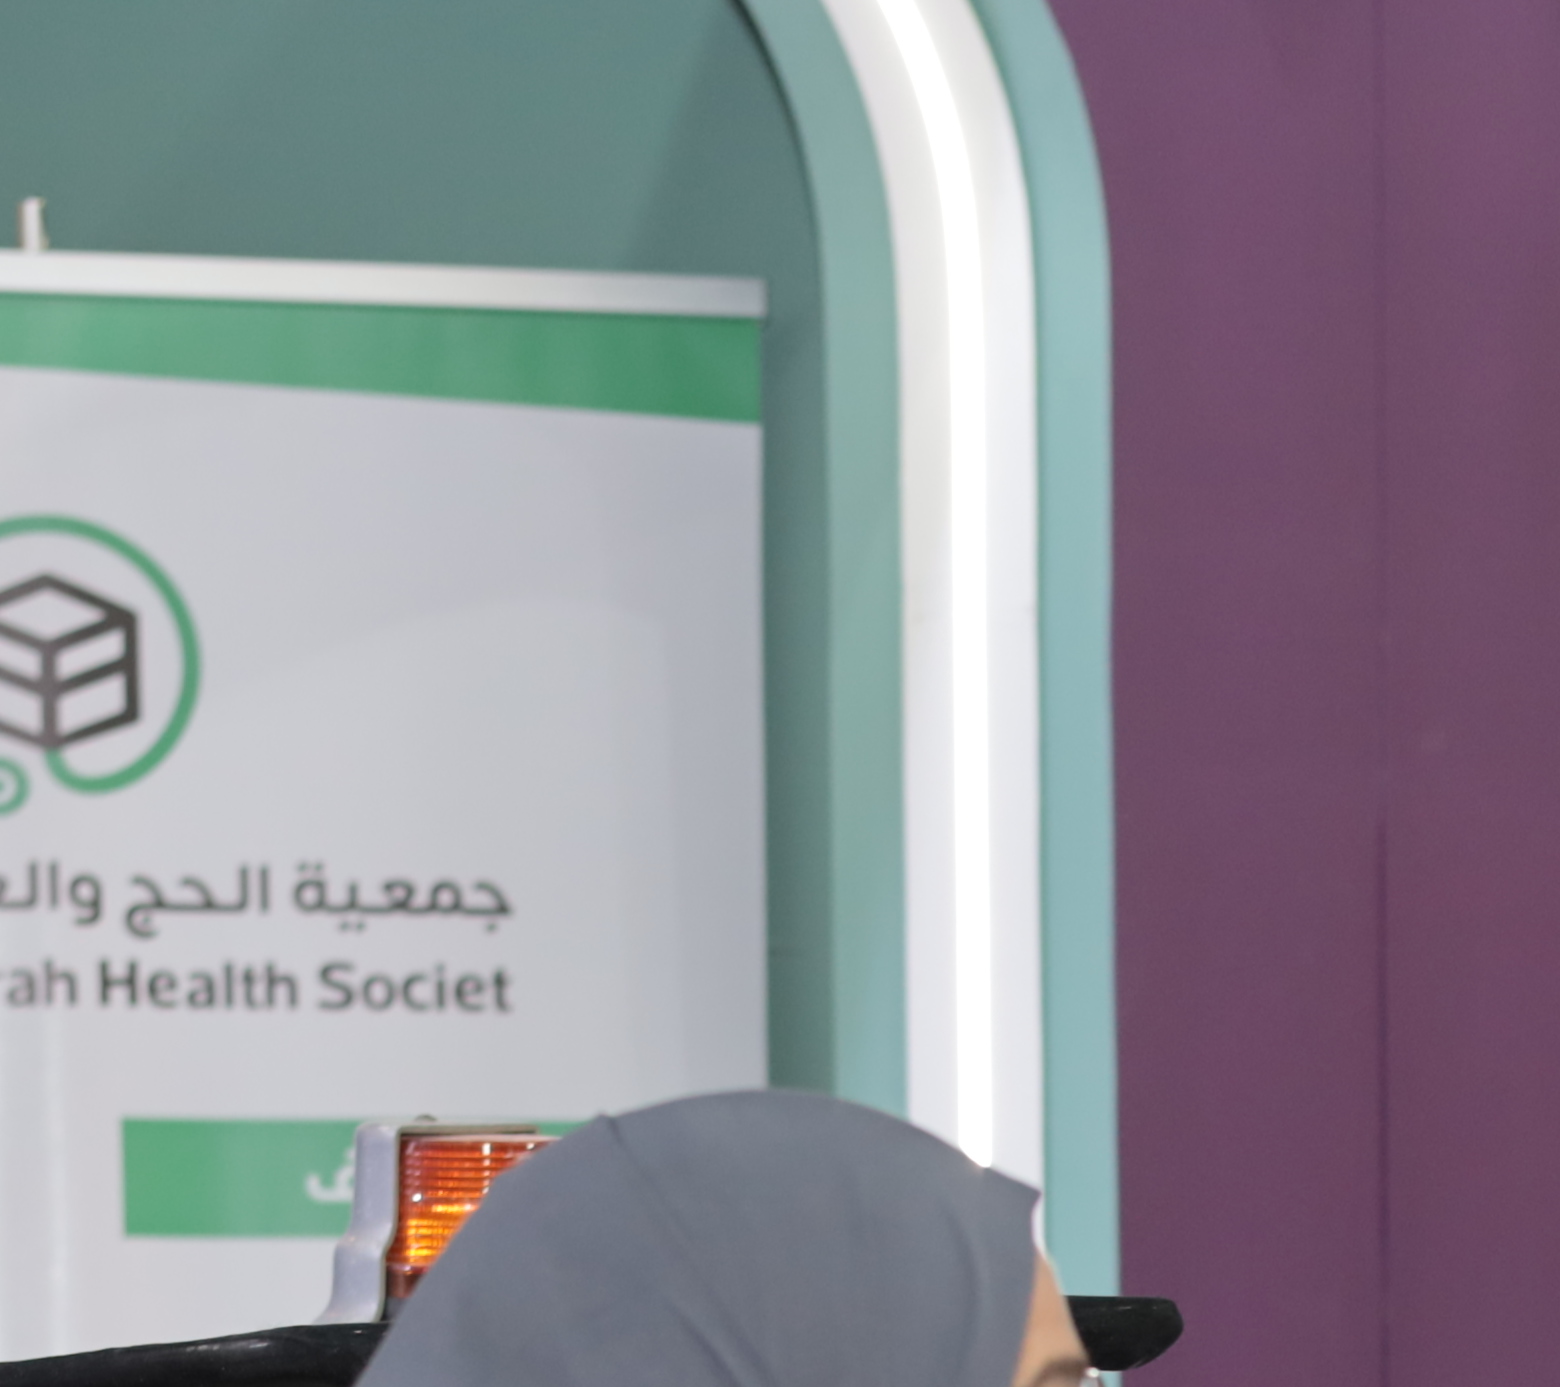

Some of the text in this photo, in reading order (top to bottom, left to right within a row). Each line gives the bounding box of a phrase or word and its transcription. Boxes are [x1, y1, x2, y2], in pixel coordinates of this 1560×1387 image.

[124, 866, 270, 938] الحج
[294, 860, 514, 933] جمعية
[98, 959, 298, 1010] Health
[318, 961, 513, 1012] Societ
